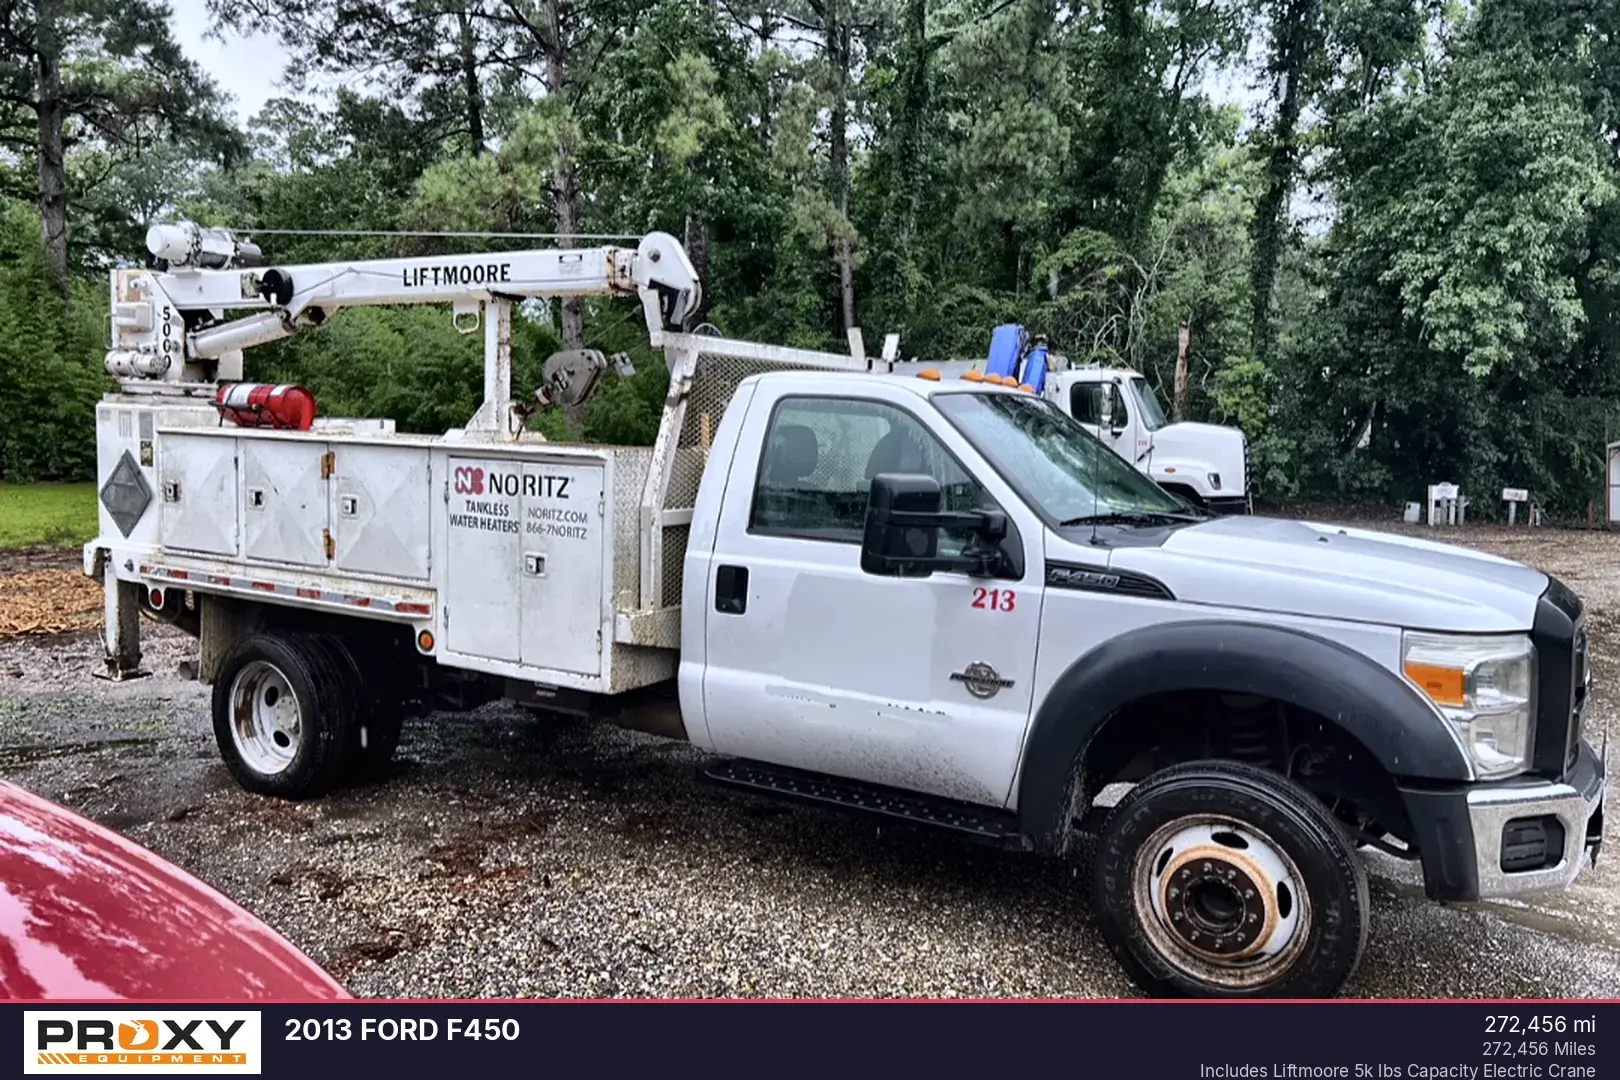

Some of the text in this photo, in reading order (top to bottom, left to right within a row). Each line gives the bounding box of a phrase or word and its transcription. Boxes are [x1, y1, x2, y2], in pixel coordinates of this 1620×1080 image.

[403, 263, 511, 287] LIFTMOORE
[489, 472, 570, 498] NORITZ
[465, 499, 509, 517] TANKLESS
[528, 506, 588, 524] NORITZ.COM
[450, 513, 520, 534] WATER HEATERS
[526, 522, 587, 540] 866-7NORITZ
[971, 587, 1016, 612] 213
